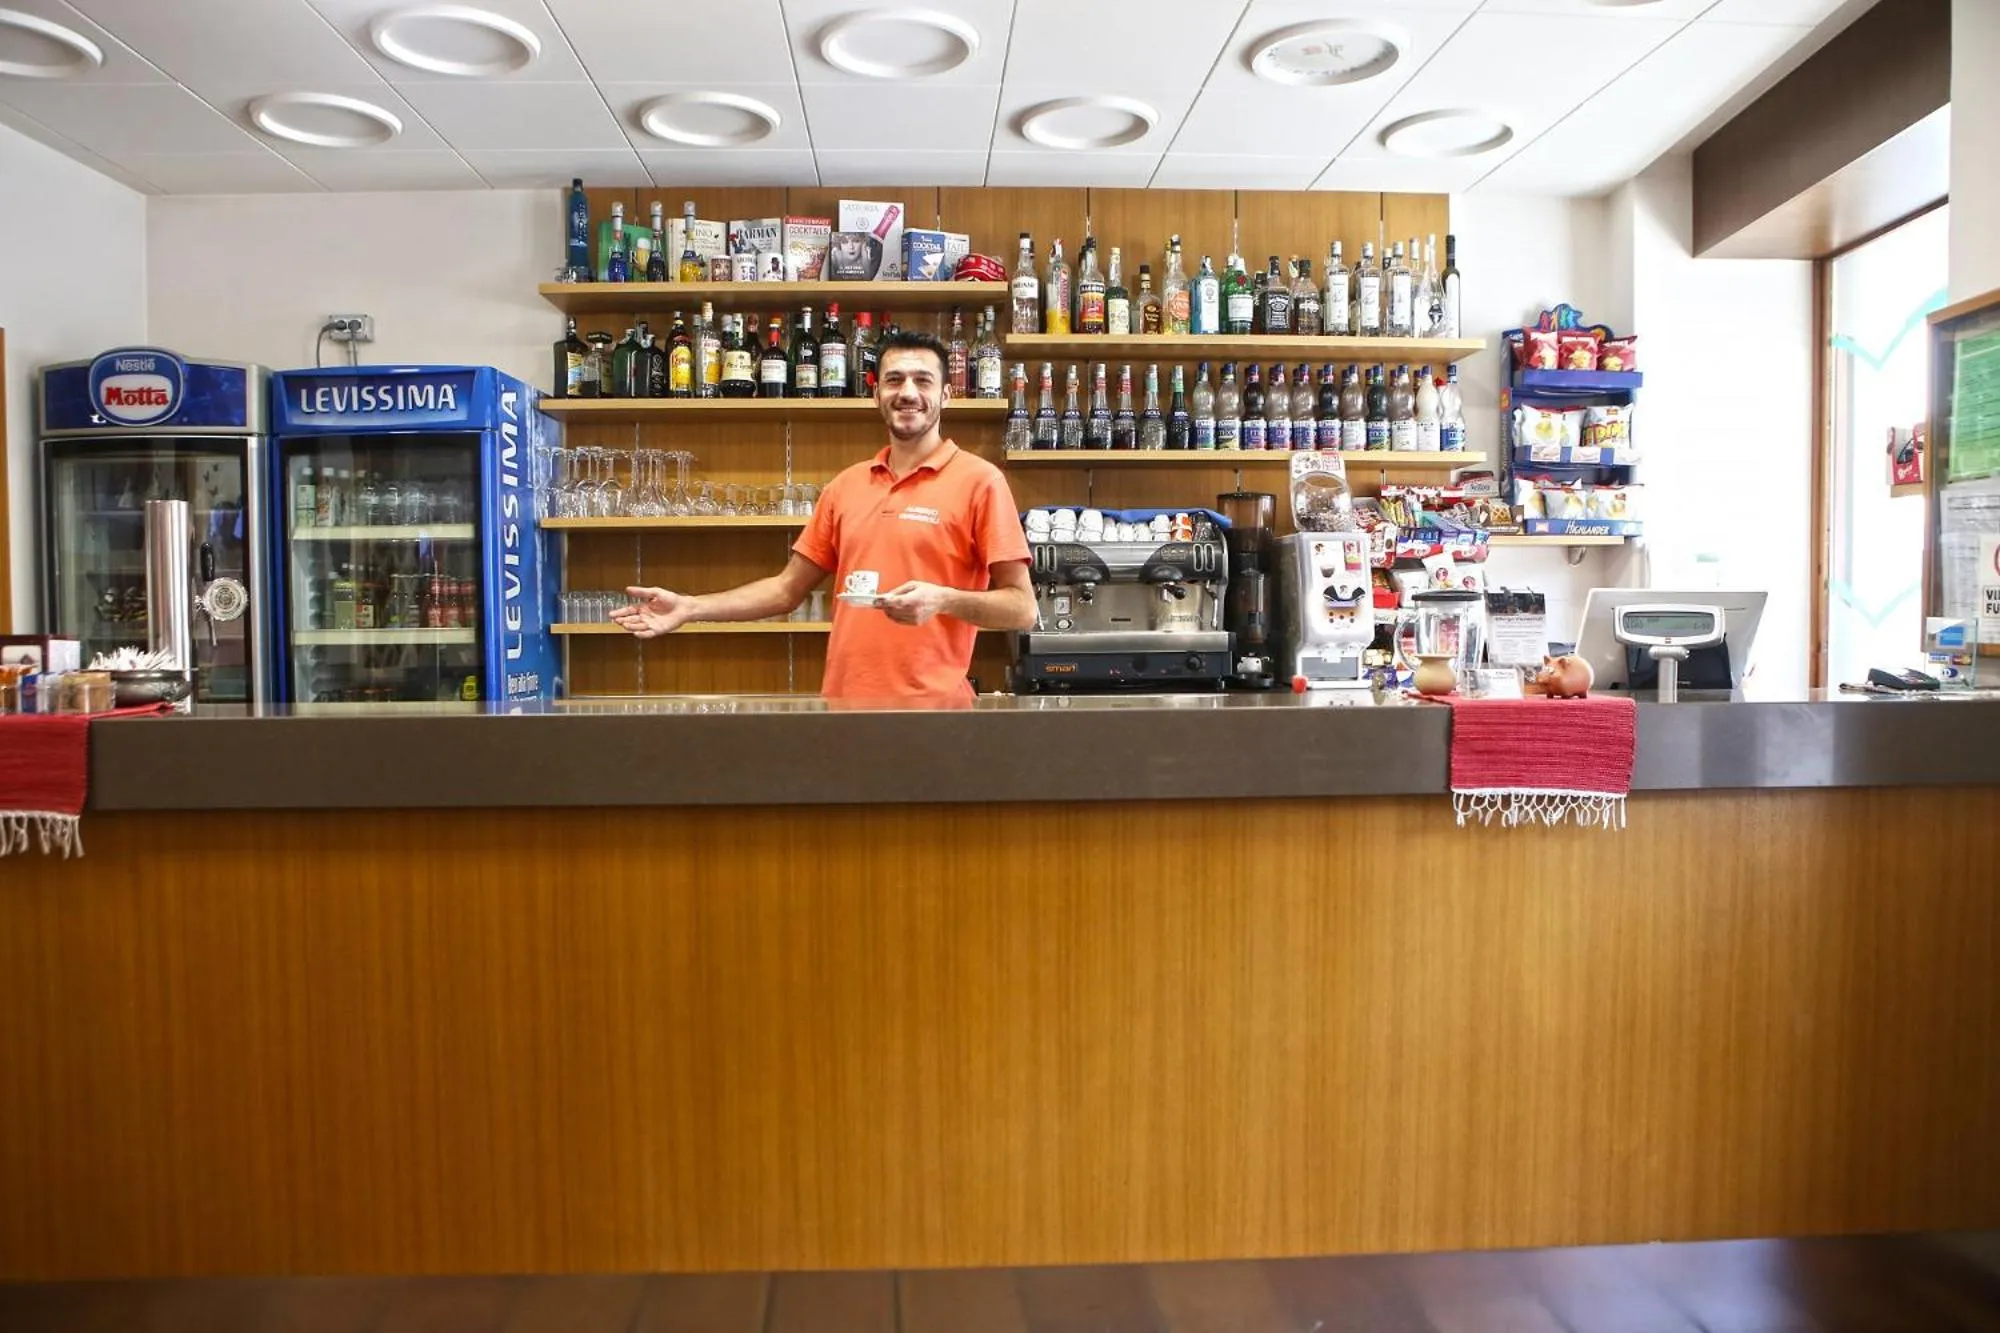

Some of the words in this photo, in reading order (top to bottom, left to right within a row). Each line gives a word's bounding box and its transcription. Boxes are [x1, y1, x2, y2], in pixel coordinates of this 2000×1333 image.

[104, 386, 169, 406] Motta
[300, 383, 457, 413] LEVISSIMA
[501, 391, 523, 660] LEVISSIMA
